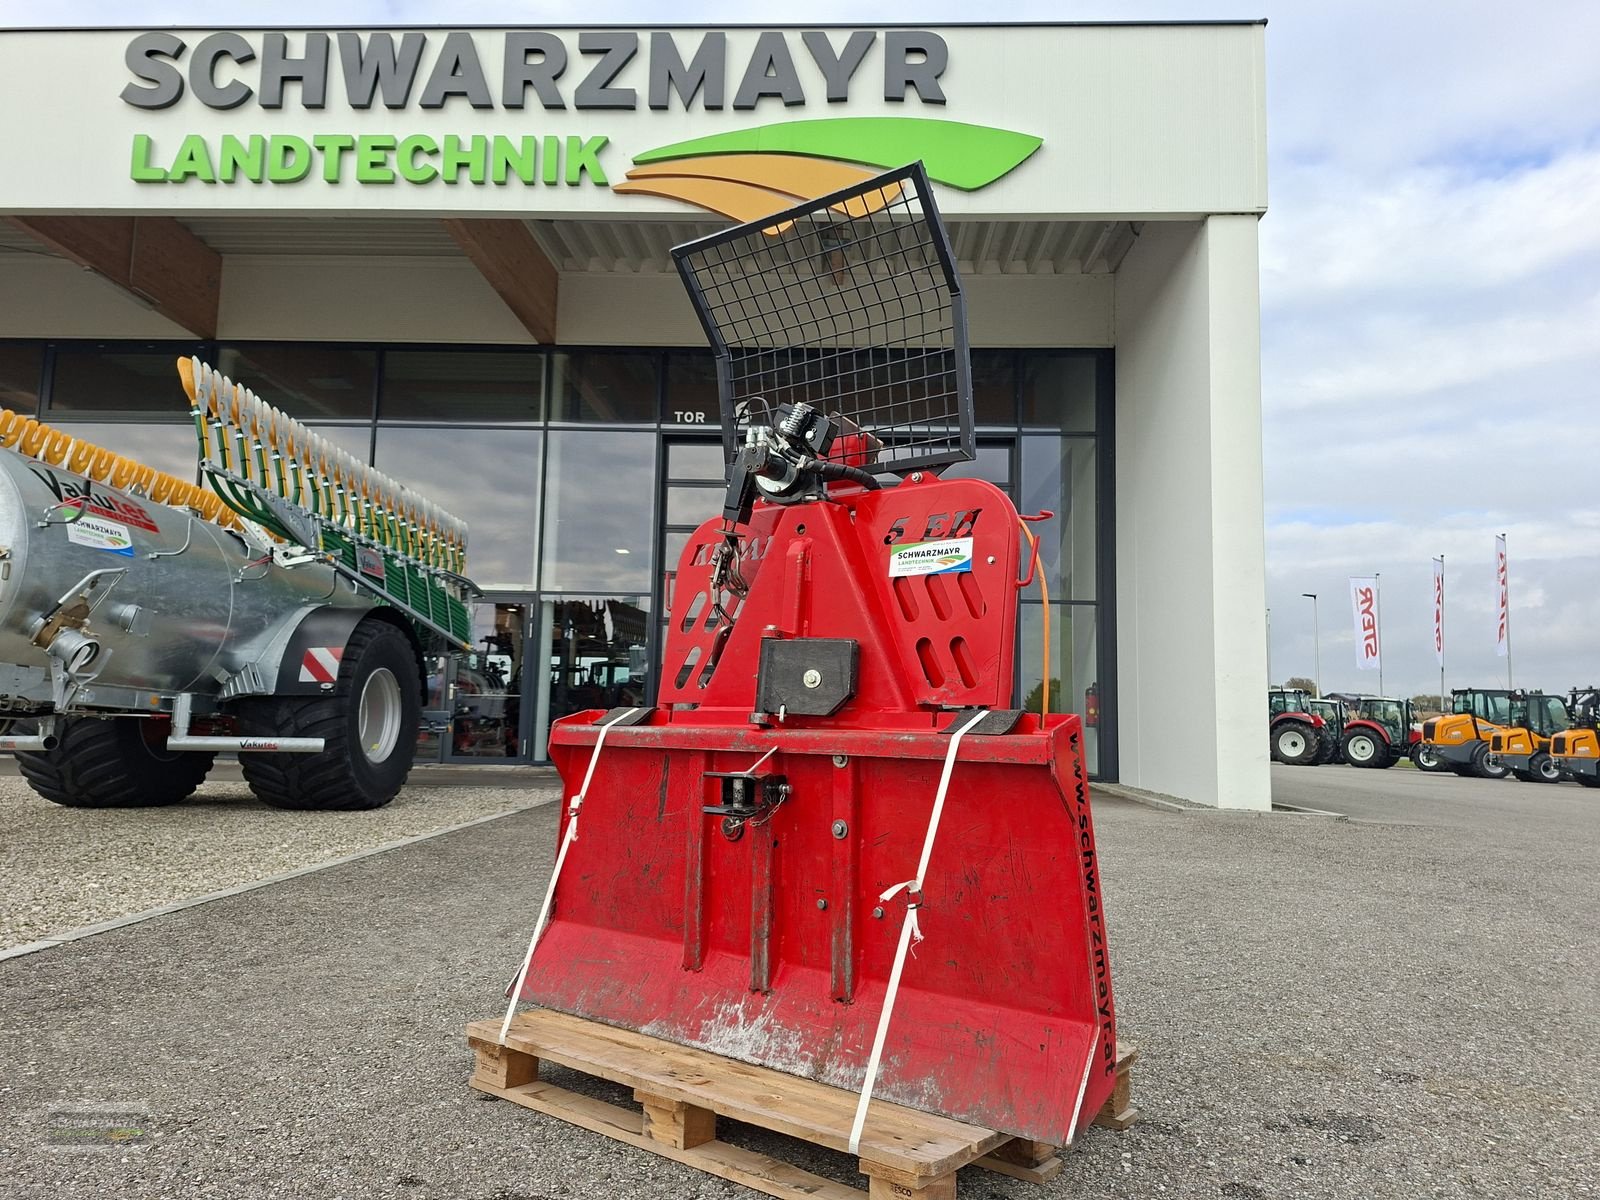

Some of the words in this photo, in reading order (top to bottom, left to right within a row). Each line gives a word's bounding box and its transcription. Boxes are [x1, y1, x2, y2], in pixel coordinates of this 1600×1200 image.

[119, 28, 949, 112] SCHWARZMAYR
[130, 134, 610, 188] LANDTECHNIK
[674, 411, 706, 424] TOR
[897, 547, 961, 560] SCHWARZMAYR
[239, 738, 278, 750] Vakutec
[1069, 731, 1116, 1078] www.schwarzmayr.at
